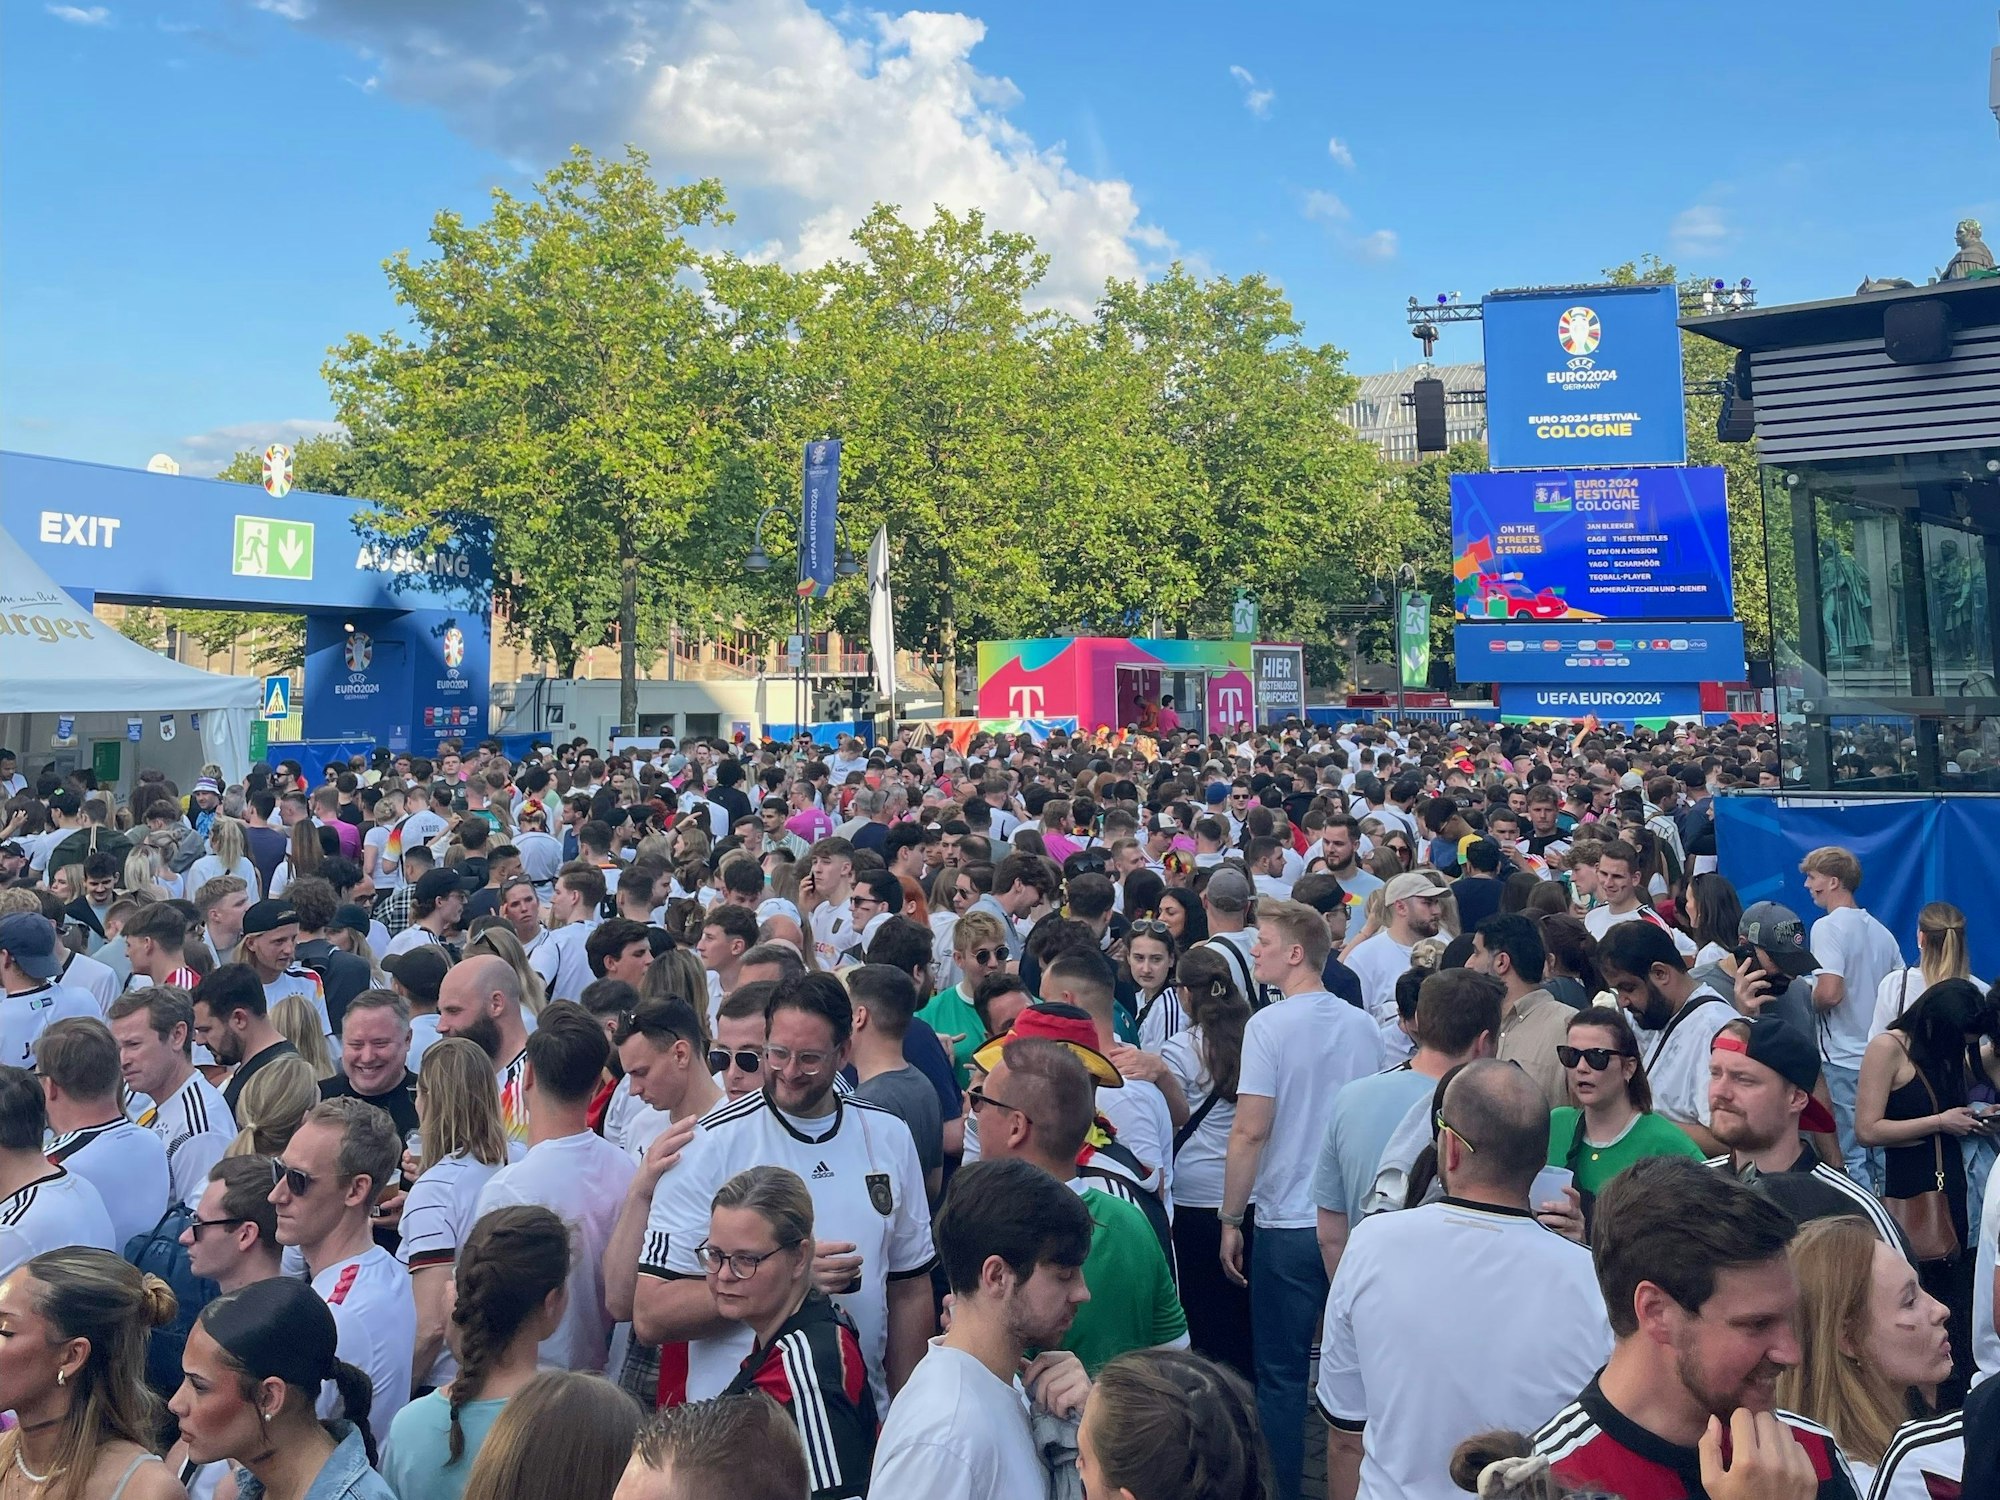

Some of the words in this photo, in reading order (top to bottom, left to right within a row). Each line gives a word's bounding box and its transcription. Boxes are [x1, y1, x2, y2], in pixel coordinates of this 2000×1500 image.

[1567, 358, 1594, 370] UEFA
[1547, 370, 1617, 384] EURO2024
[1562, 382, 1601, 391] GERMANY
[1528, 415, 1559, 425] EURO
[1560, 414, 1588, 424] 2024
[1589, 412, 1641, 422] FESTIVAL
[1536, 423, 1632, 439] COLOGNE
[1574, 479, 1606, 489] EURO
[1608, 478, 1639, 488] 2024
[1575, 488, 1639, 500] FESTIVAL
[1575, 500, 1640, 511] COLOGNE
[40, 511, 121, 548] EXIT
[1500, 525, 1514, 534] ON
[1515, 525, 1536, 533] THE
[1602, 522, 1634, 530] BLEEKER
[1497, 535, 1540, 544] STREETS
[1627, 534, 1668, 542] STREETLES
[1495, 546, 1504, 554] &
[1504, 545, 1542, 554] STAGES
[1627, 547, 1658, 555] MISSION
[355, 544, 470, 578] AUSGANG
[1589, 573, 1651, 581] TEQBALL-PLAYER
[1589, 584, 1659, 593] KAMMERKÄTZCHEN
[1262, 657, 1291, 678] HIER
[335, 684, 379, 694] EURO2024
[1258, 680, 1298, 690] KOSTENLOSER
[1009, 686, 1044, 719] T
[1536, 691, 1662, 705] UEFAEURO2024
[1219, 688, 1243, 728] T
[811, 1171, 835, 1180] adidas
